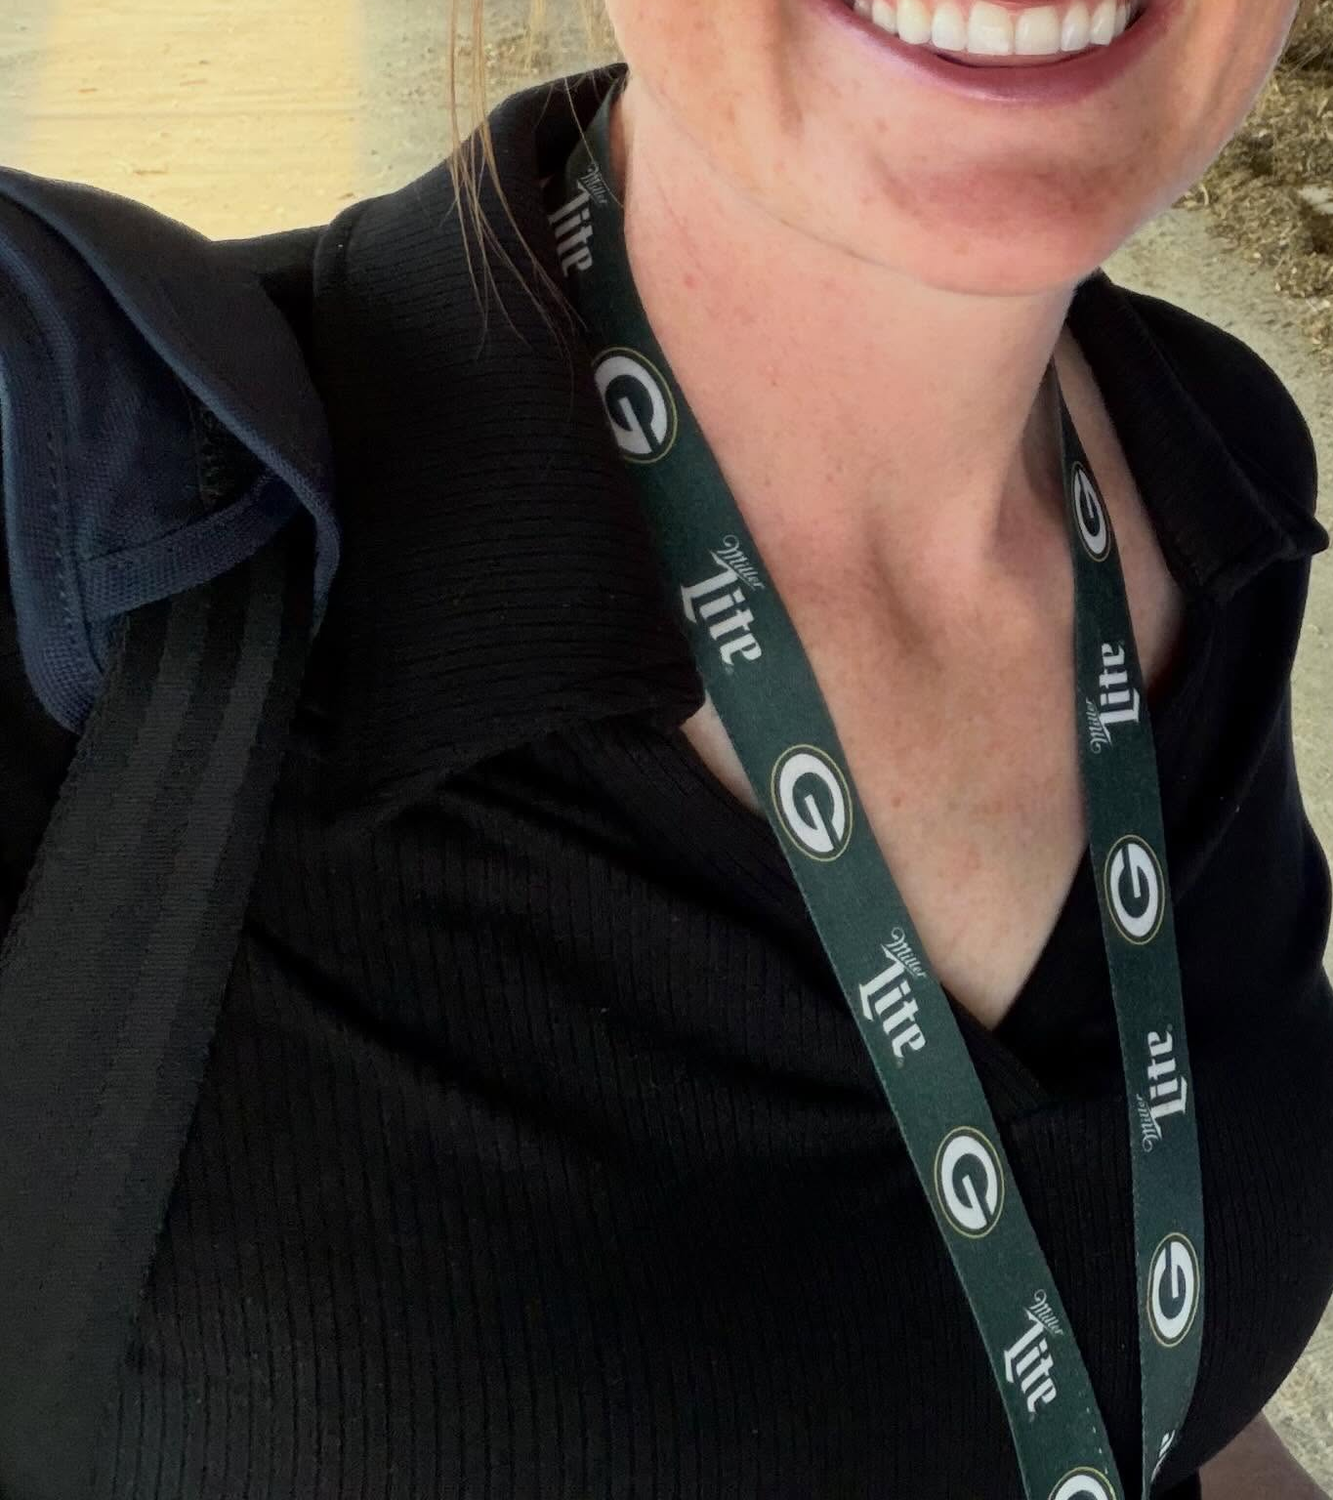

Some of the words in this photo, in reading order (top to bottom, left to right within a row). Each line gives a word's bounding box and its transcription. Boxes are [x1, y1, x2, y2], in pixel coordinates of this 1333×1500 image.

[595, 356, 667, 454] G
[1074, 468, 1107, 554] G
[681, 550, 762, 666] Lite
[717, 534, 765, 590] Miller
[1085, 696, 1109, 755] Miller
[1099, 643, 1140, 747] Lite
[780, 754, 845, 853] G
[1109, 843, 1160, 938] G
[859, 943, 926, 1057] Lite
[885, 927, 927, 978] Miller
[1136, 1094, 1160, 1153] Miller
[1147, 1031, 1187, 1140] Lite
[940, 1135, 998, 1230] G
[1029, 1289, 1063, 1335] Miller
[1152, 1241, 1195, 1340] G
[1003, 1307, 1057, 1410] Lite
